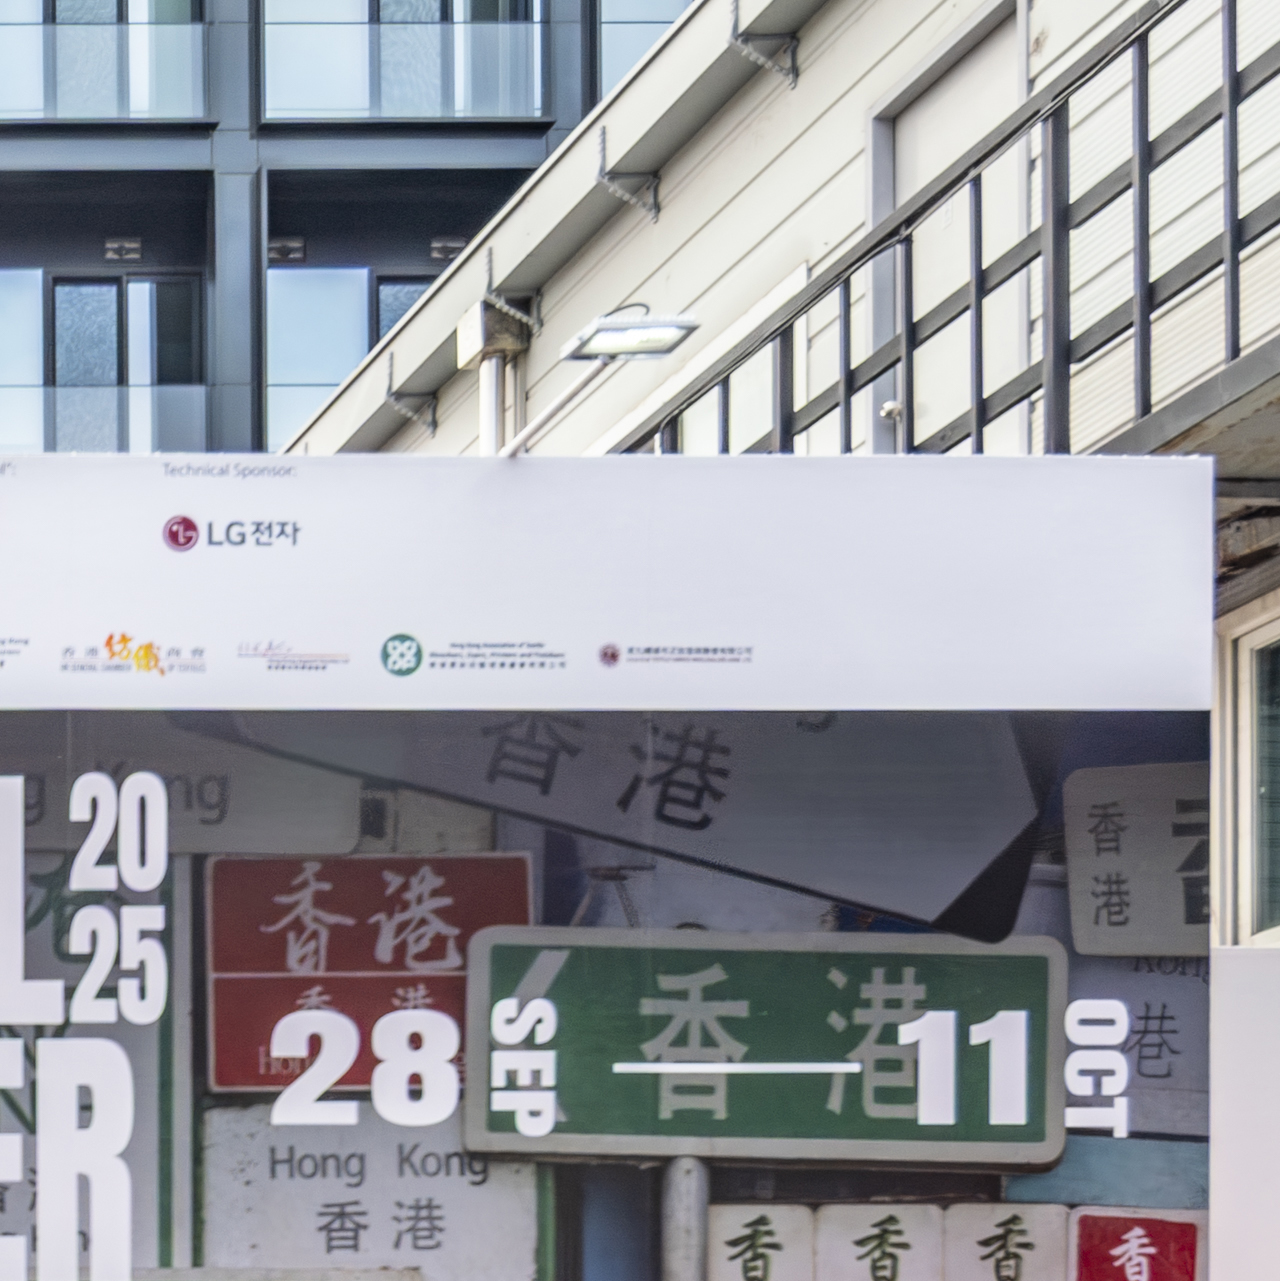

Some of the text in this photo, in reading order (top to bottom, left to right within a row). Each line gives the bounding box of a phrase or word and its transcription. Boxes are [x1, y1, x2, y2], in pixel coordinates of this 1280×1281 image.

[163, 461, 297, 480] Technical Sponsor:
[207, 521, 302, 546] LG전자
[68, 770, 169, 892] 20
[481, 715, 732, 832] 香港
[258, 860, 464, 973] 香港
[1087, 801, 1131, 927] 香港
[68, 904, 169, 1025] 25
[270, 997, 1130, 1139] 28 SEP 11 OCT
[641, 963, 927, 1120] 香港
[268, 1144, 489, 1187] Hong Kong
[316, 1199, 446, 1254] 香港
